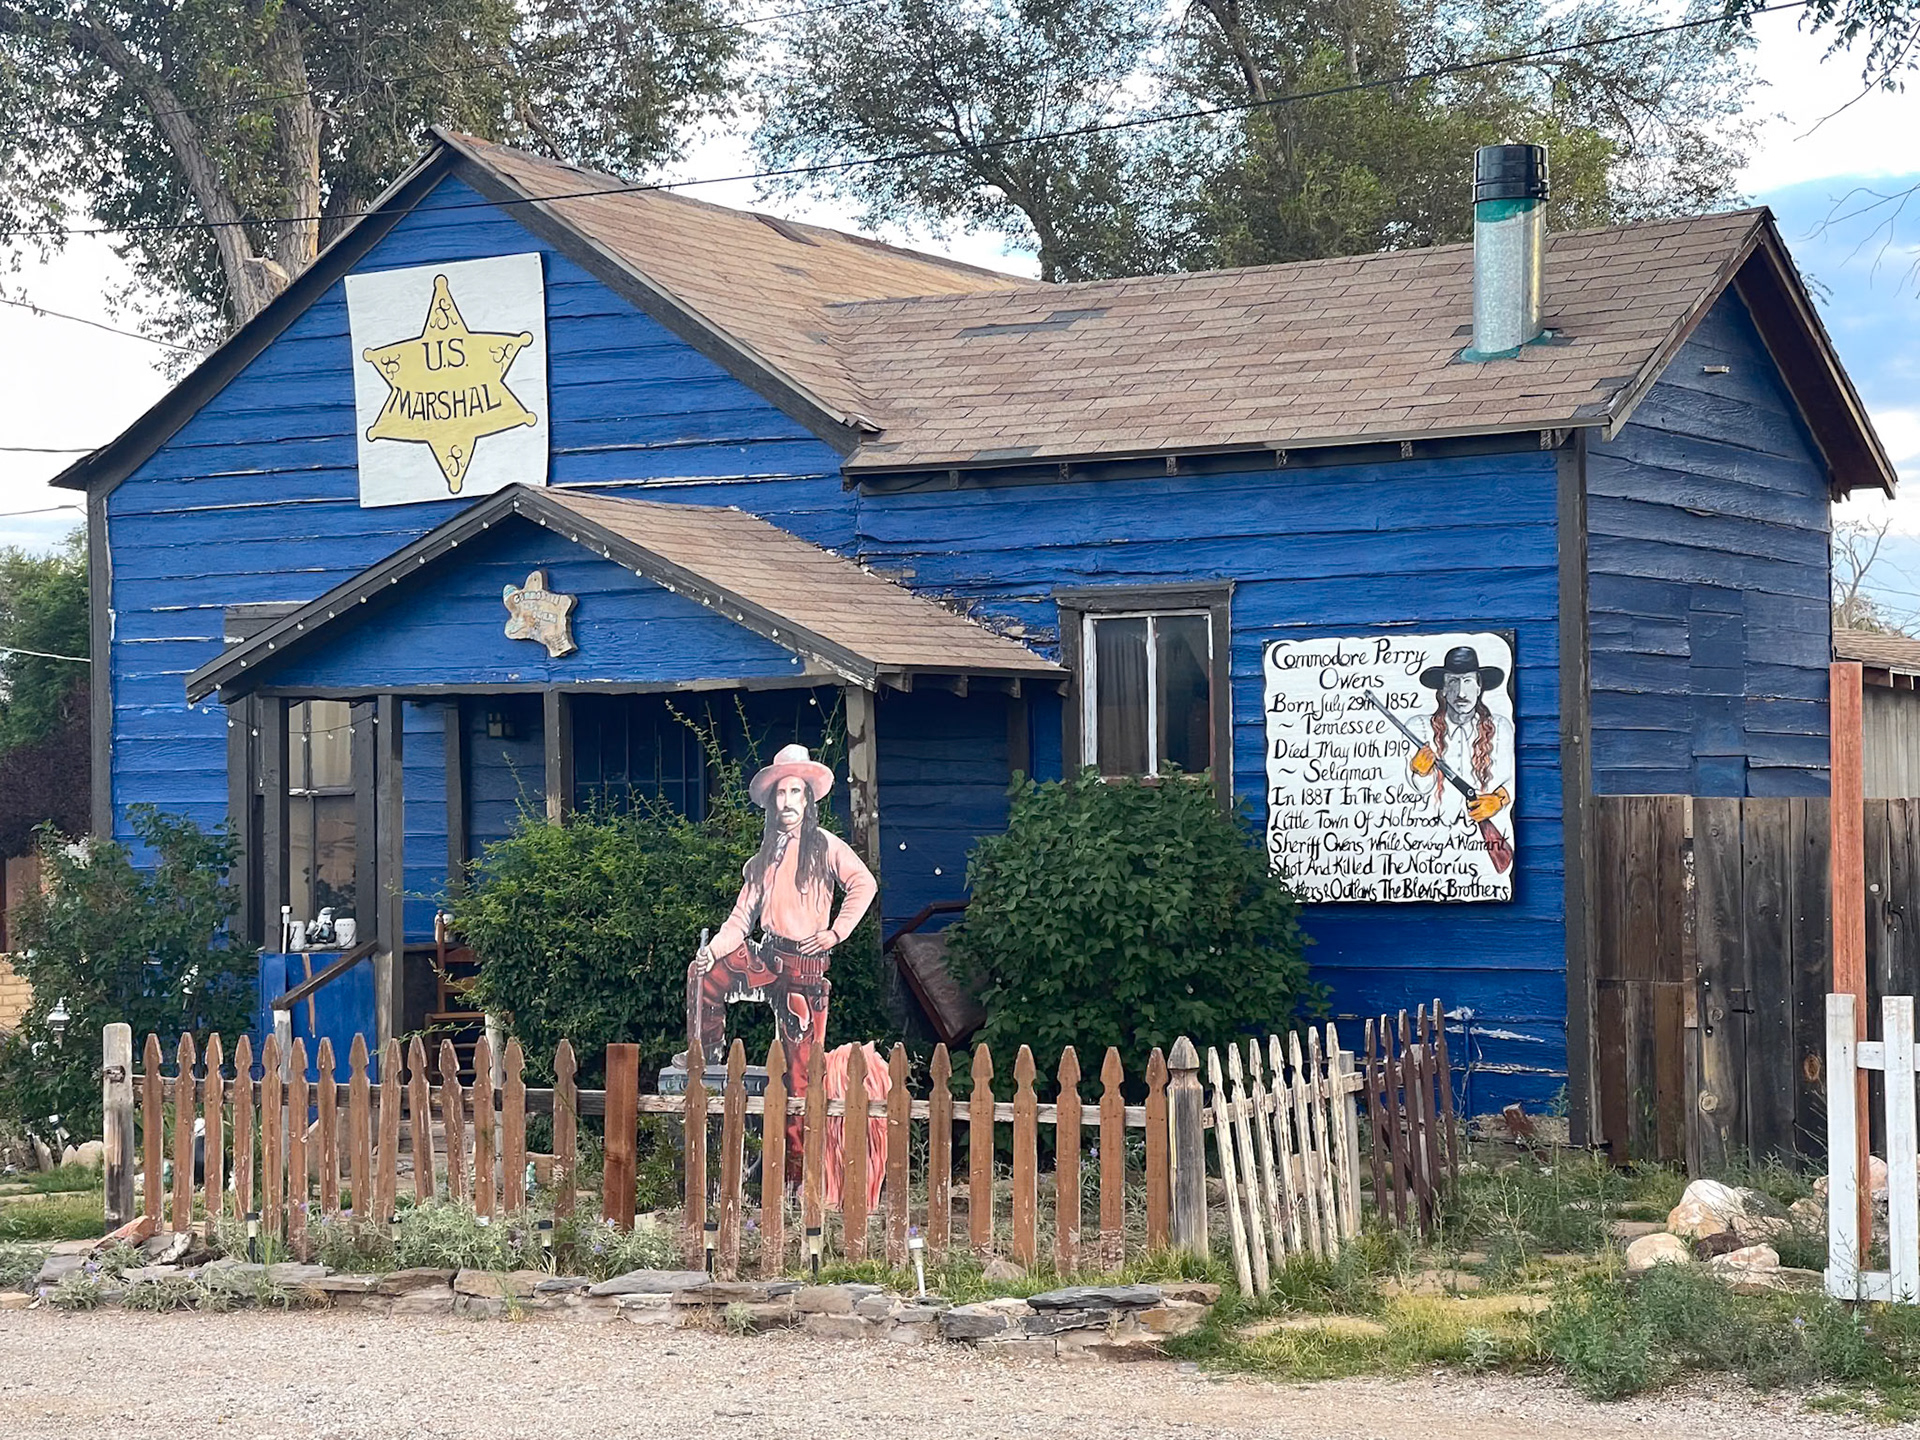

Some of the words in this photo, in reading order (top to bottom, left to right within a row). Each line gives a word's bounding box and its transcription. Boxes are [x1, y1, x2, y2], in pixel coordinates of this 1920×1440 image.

[422, 338, 468, 371] U.S.
[389, 384, 501, 421] MARSHAL
[1272, 642, 1369, 669] Commodore
[1374, 638, 1430, 675] Perry
[1320, 668, 1384, 689] Owens
[1267, 693, 1319, 713] Born
[1312, 693, 1345, 720] July
[1347, 696, 1376, 711] 29th
[1385, 692, 1422, 709] 1852
[1301, 713, 1390, 735] Tennessee
[1274, 739, 1314, 759] Died
[1315, 740, 1350, 766] May
[1354, 739, 1383, 758] 10th
[1384, 740, 1410, 757] 1919
[1304, 758, 1388, 786] Seligman
[1271, 787, 1296, 806] In
[1301, 788, 1334, 806] 1887
[1340, 787, 1358, 805] In
[1358, 787, 1381, 805] The
[1384, 783, 1431, 811] Sleepy
[1271, 810, 1312, 831] Little
[1314, 810, 1348, 828] Town
[1354, 811, 1372, 836] Of
[1375, 806, 1452, 830] Holbrook,
[1270, 831, 1320, 860] Sheriff
[1323, 832, 1364, 855] Owens
[1367, 830, 1401, 851] While
[1403, 831, 1443, 858] Serving
[1444, 833, 1456, 850] A
[1456, 829, 1510, 851] Warrant
[1270, 855, 1304, 876] Shot
[1304, 856, 1331, 875] And
[1333, 854, 1377, 877] Killed
[1377, 853, 1403, 875] The
[1400, 851, 1478, 876] Notorius
[1378, 878, 1400, 899] The
